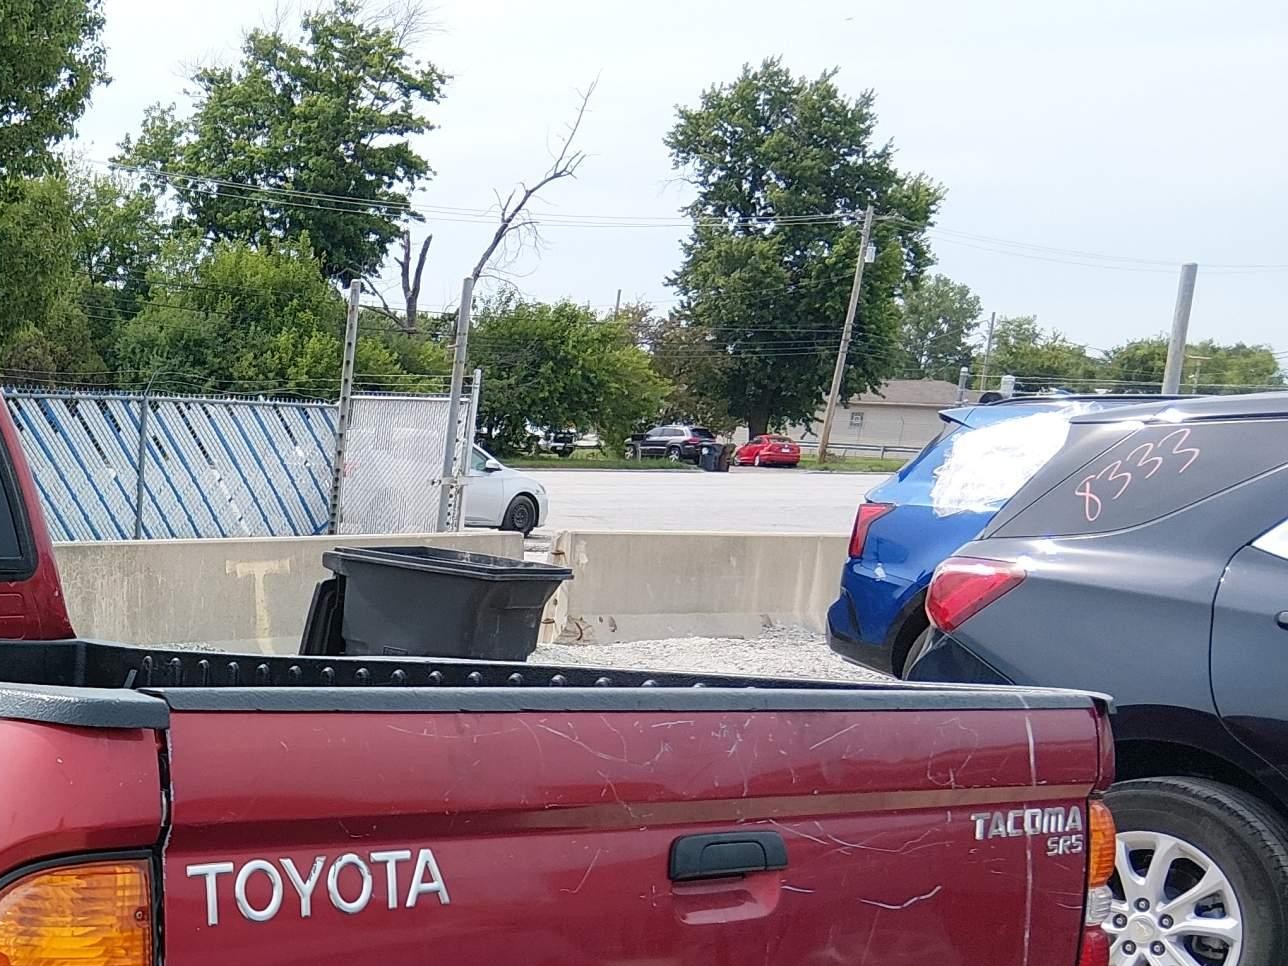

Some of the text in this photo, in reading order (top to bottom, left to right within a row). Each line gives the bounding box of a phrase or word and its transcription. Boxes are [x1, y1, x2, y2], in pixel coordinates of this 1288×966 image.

[1074, 428, 1200, 521] 8333
[970, 806, 1083, 840] TACOMA
[1046, 834, 1085, 857] SR5
[186, 848, 450, 926] TOYOTA
